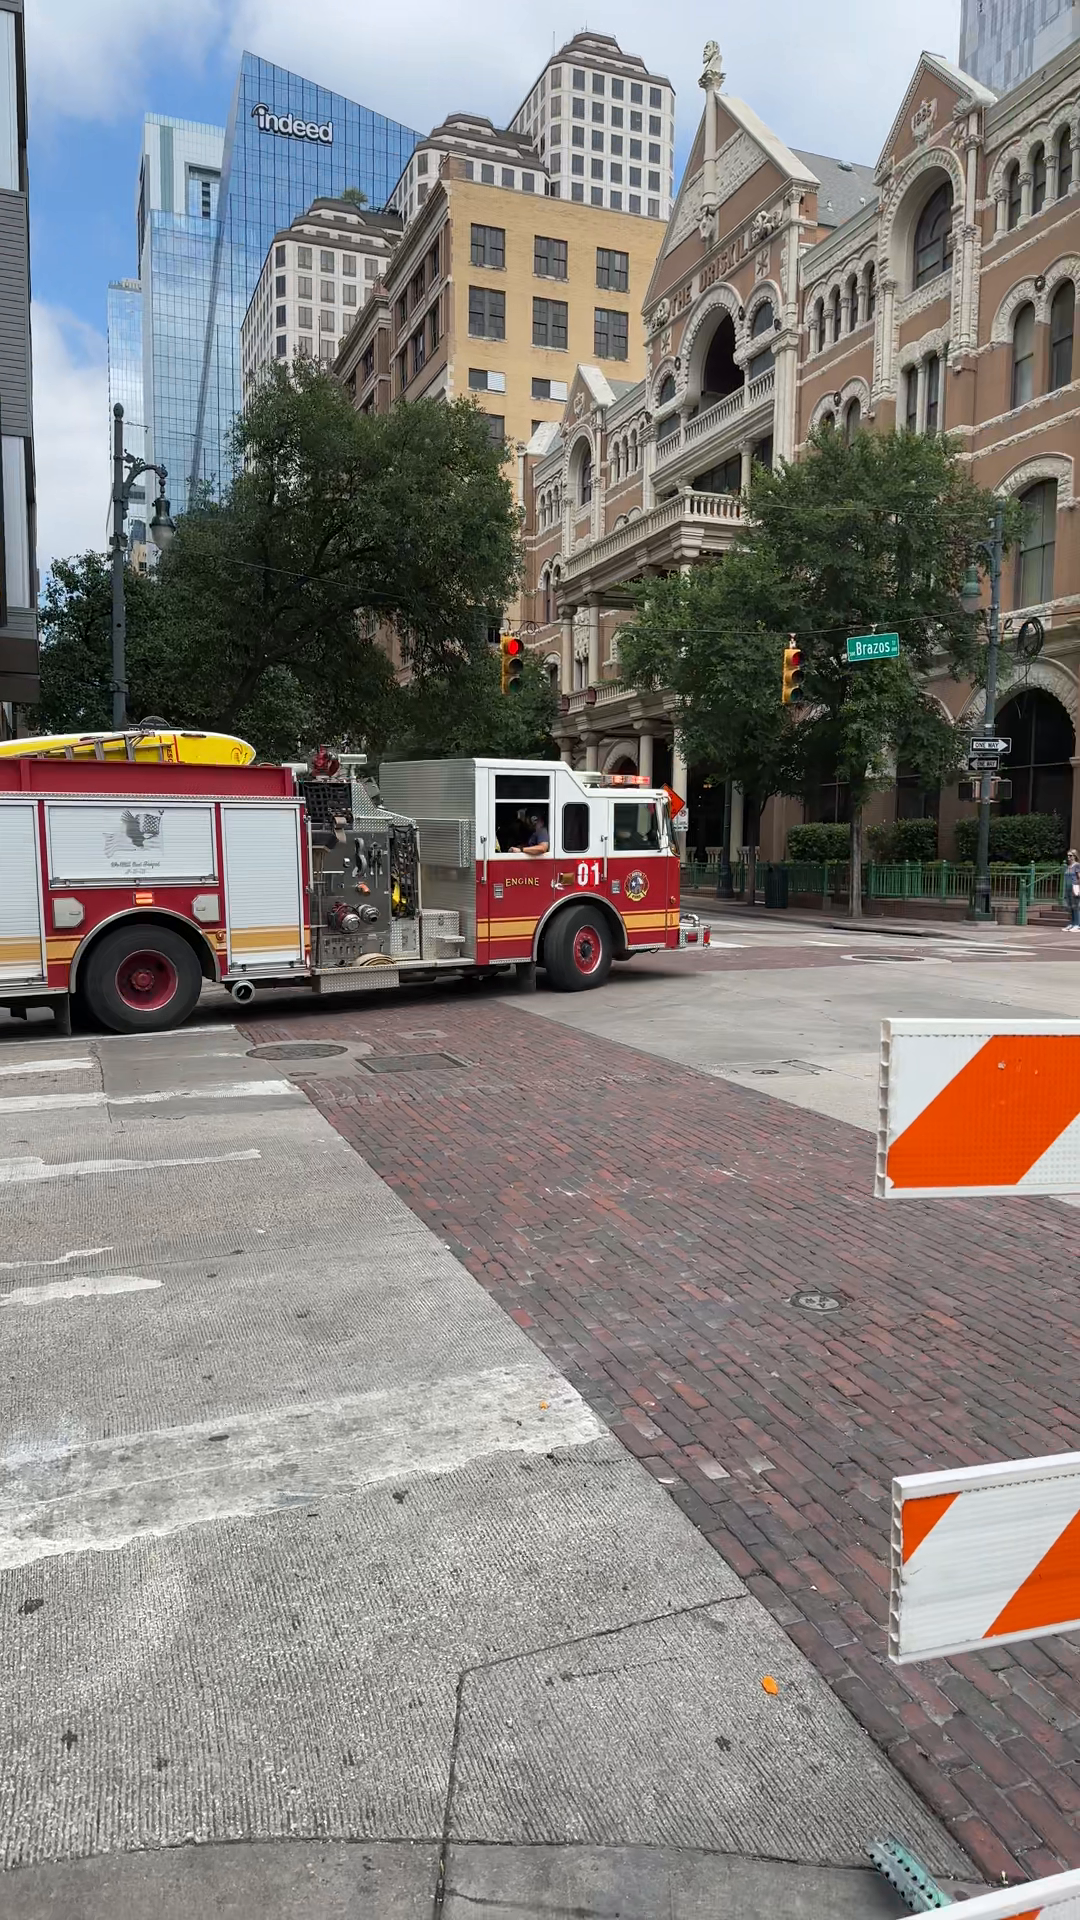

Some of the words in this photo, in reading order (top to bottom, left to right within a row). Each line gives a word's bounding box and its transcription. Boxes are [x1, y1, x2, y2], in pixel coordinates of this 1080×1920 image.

[254, 103, 333, 143] indeed
[913, 107, 931, 127] 1885
[670, 281, 692, 317] THE
[855, 641, 890, 656] Brazos
[505, 877, 540, 888] ENGINE
[577, 862, 600, 885] 01
